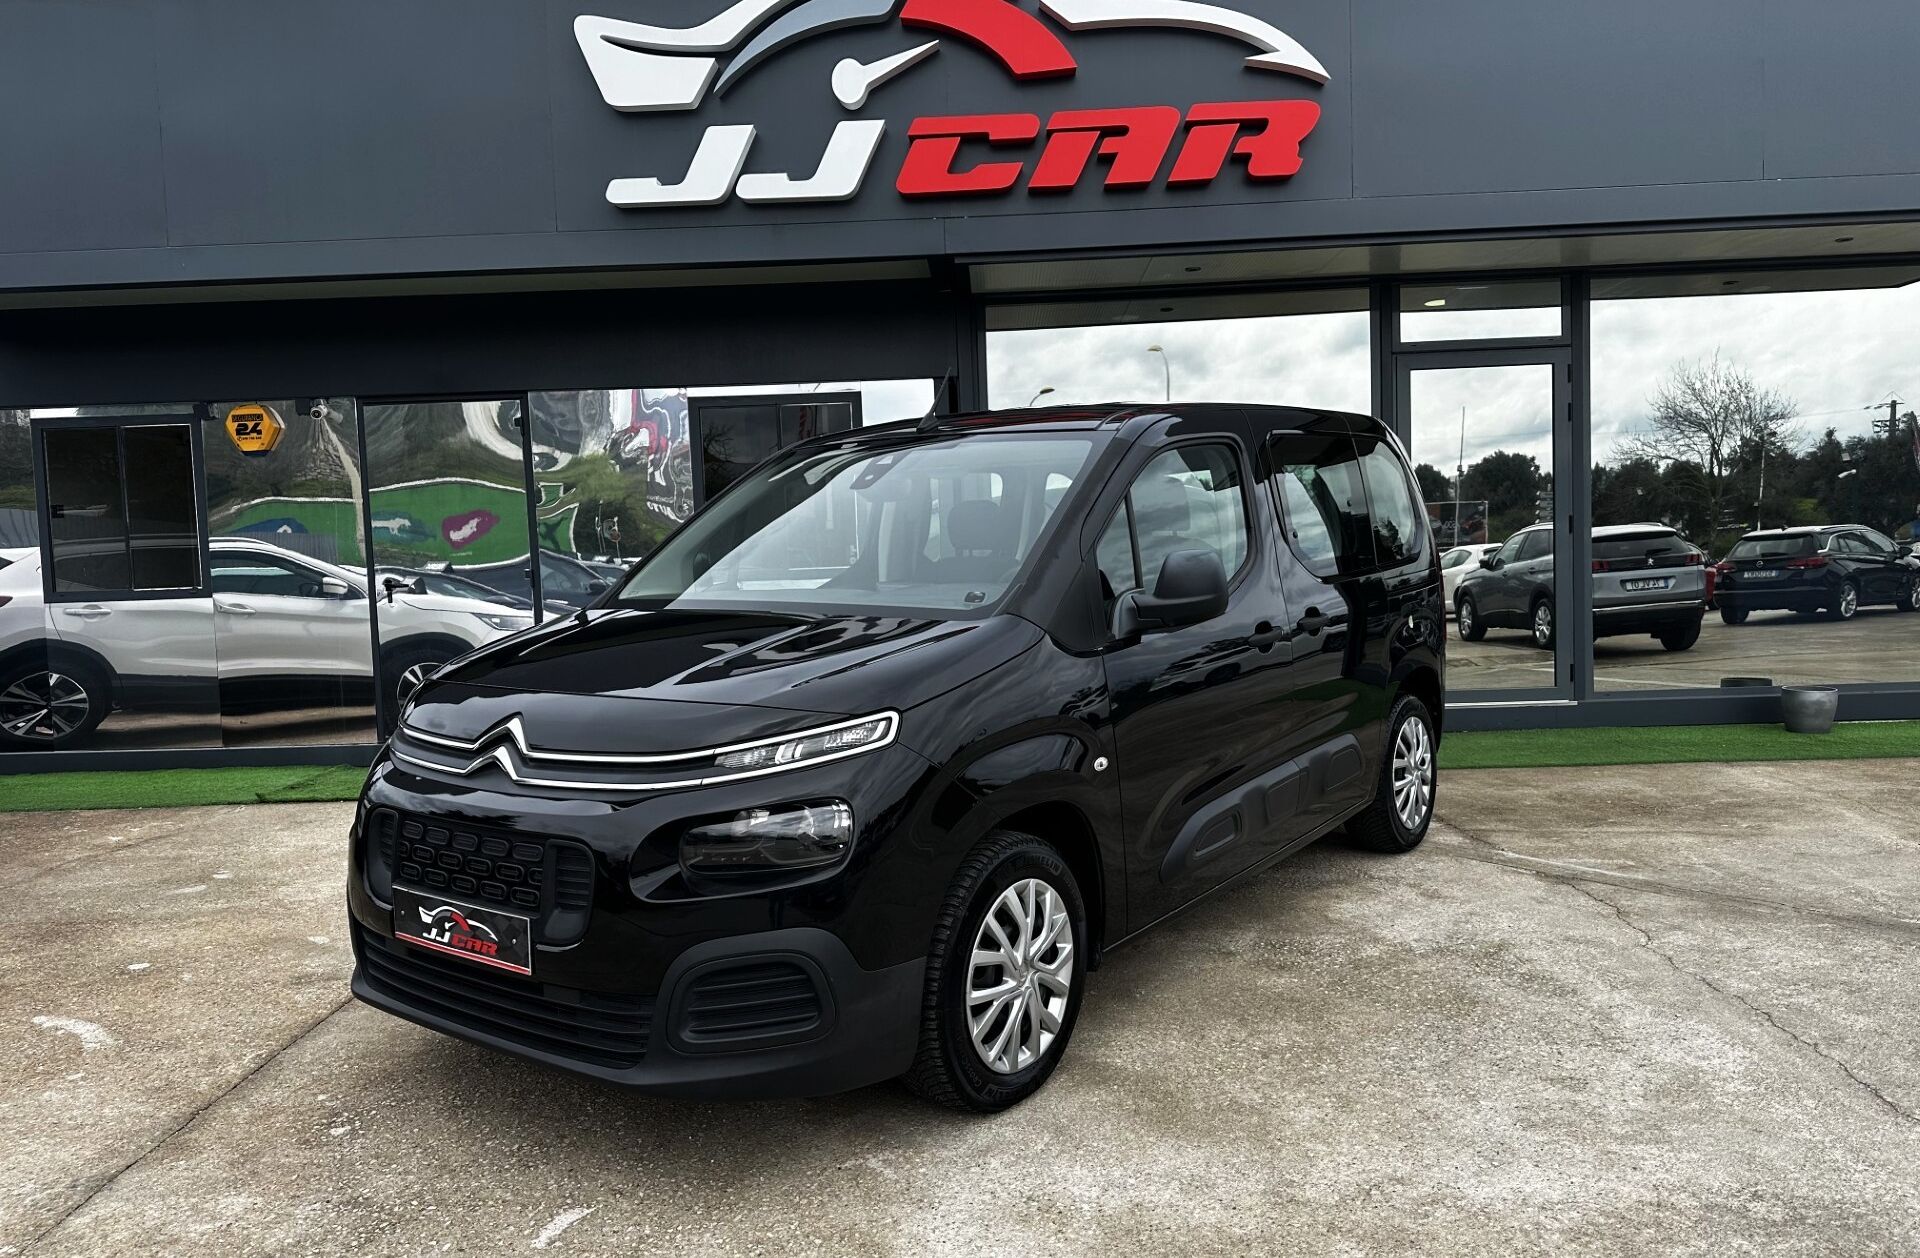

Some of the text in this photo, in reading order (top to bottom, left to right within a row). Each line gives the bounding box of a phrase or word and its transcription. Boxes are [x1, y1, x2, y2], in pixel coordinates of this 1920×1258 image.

[604, 100, 1321, 208] JJ CAR
[235, 422, 262, 435] 24
[422, 928, 498, 955] JJ CAR
